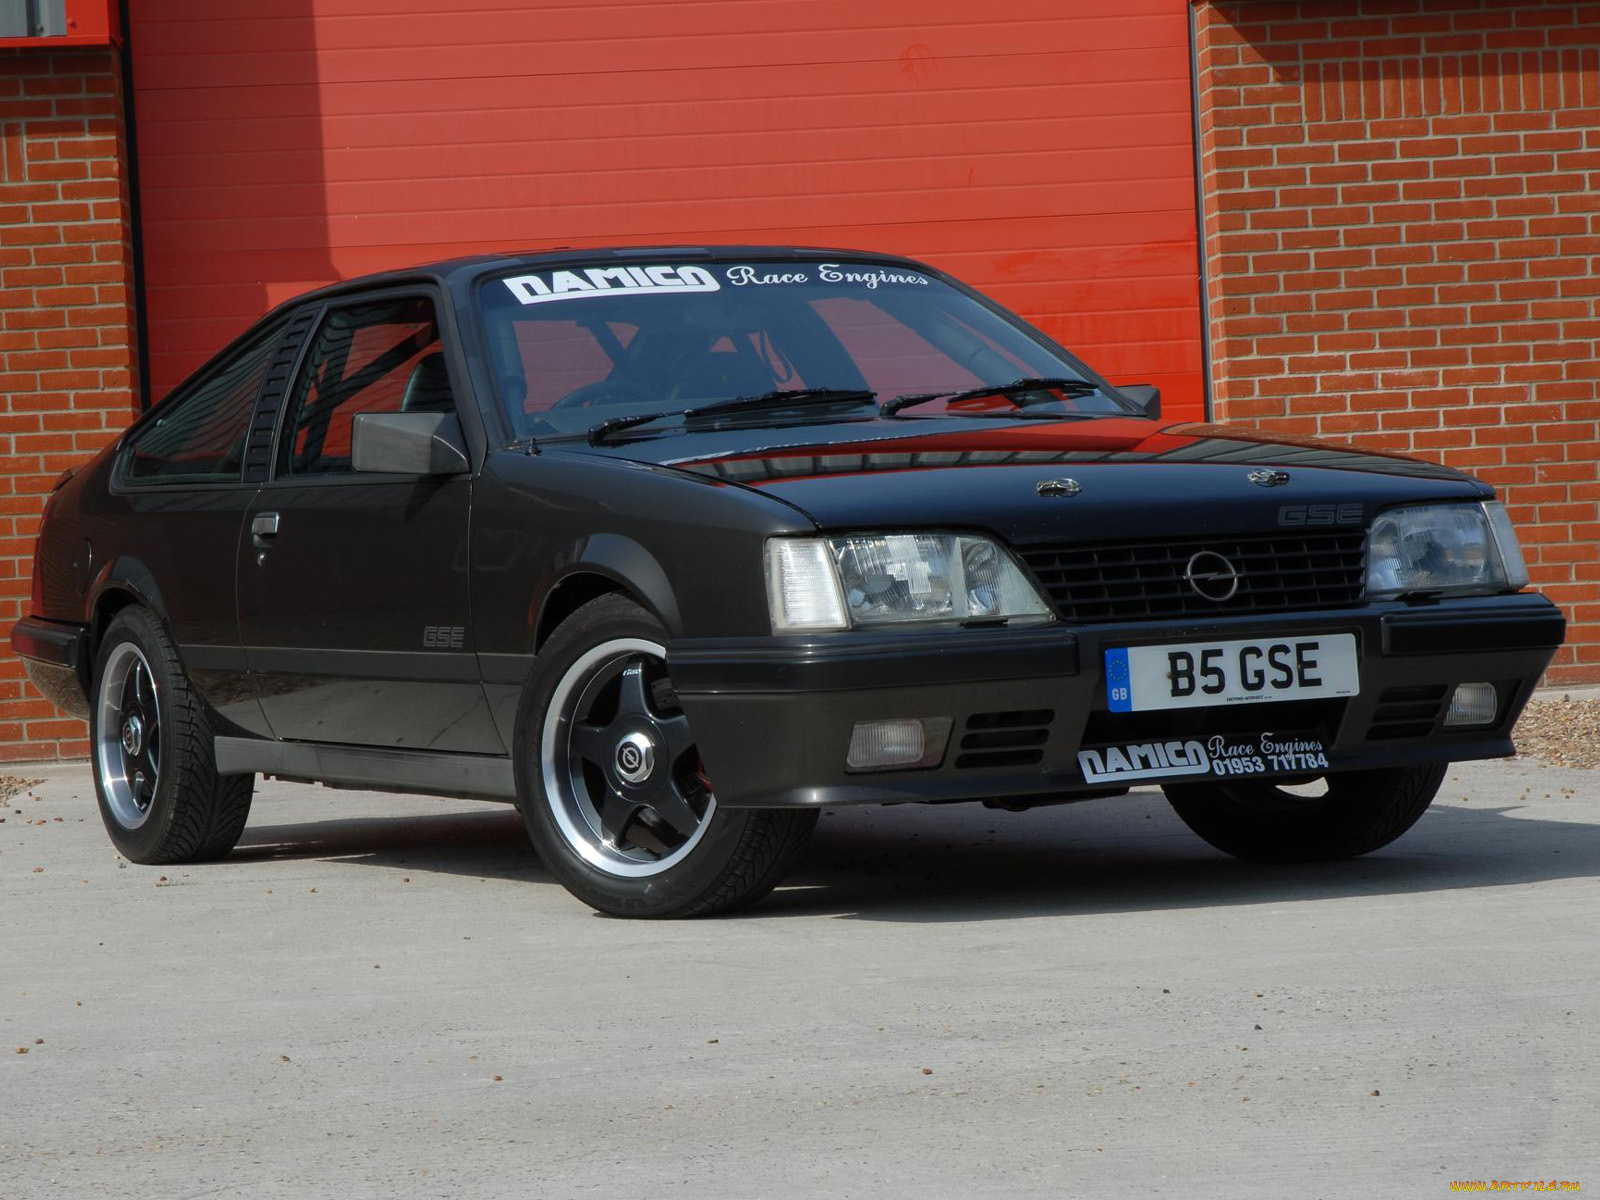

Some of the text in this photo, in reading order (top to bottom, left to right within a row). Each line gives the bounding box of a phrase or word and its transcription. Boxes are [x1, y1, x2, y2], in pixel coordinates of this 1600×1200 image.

[503, 264, 928, 305] DAMICO Race Engines
[1278, 503, 1363, 526] GSE
[423, 626, 465, 648] GSE
[1168, 642, 1322, 697] B5 GSE
[1112, 687, 1128, 701] GB
[1077, 732, 1323, 784] DAMICO Race Engines
[1212, 753, 1329, 775] 01953 717784
